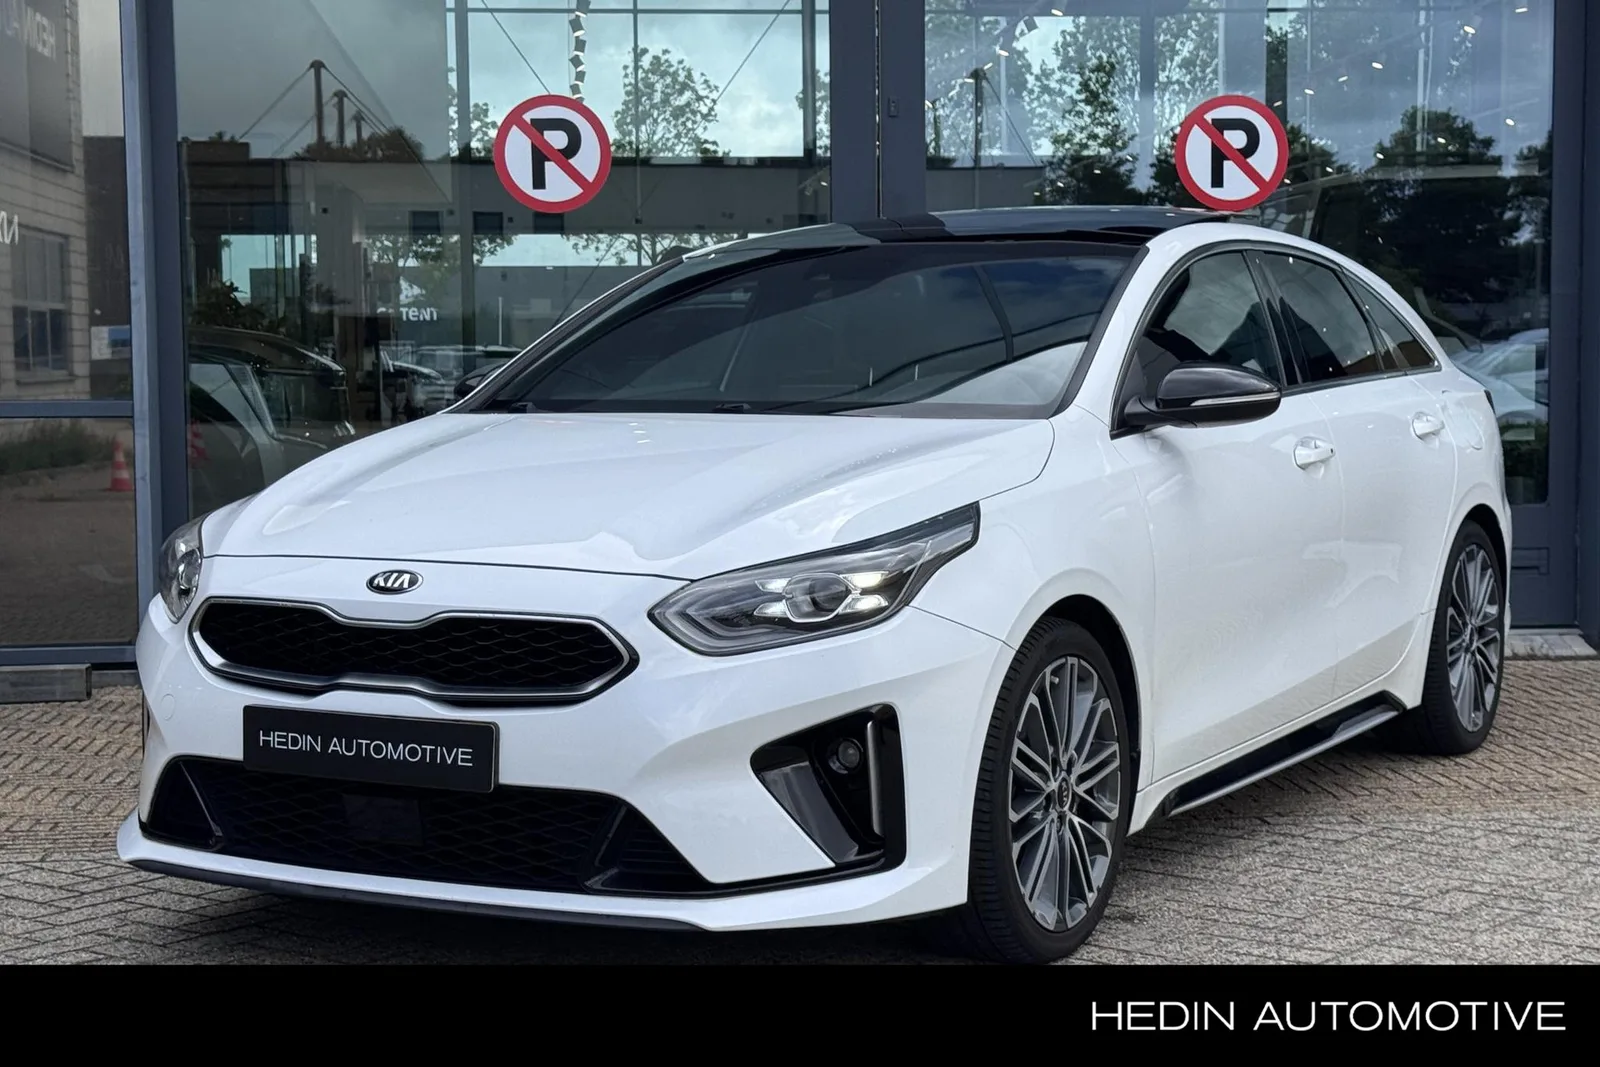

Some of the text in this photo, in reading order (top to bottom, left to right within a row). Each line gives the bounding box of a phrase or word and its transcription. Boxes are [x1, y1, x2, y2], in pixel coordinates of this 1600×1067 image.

[530, 118, 582, 190] P
[1211, 118, 1260, 188] P
[372, 572, 411, 589] KIA
[259, 730, 473, 767] HEDIN AUTOMOTIVE
